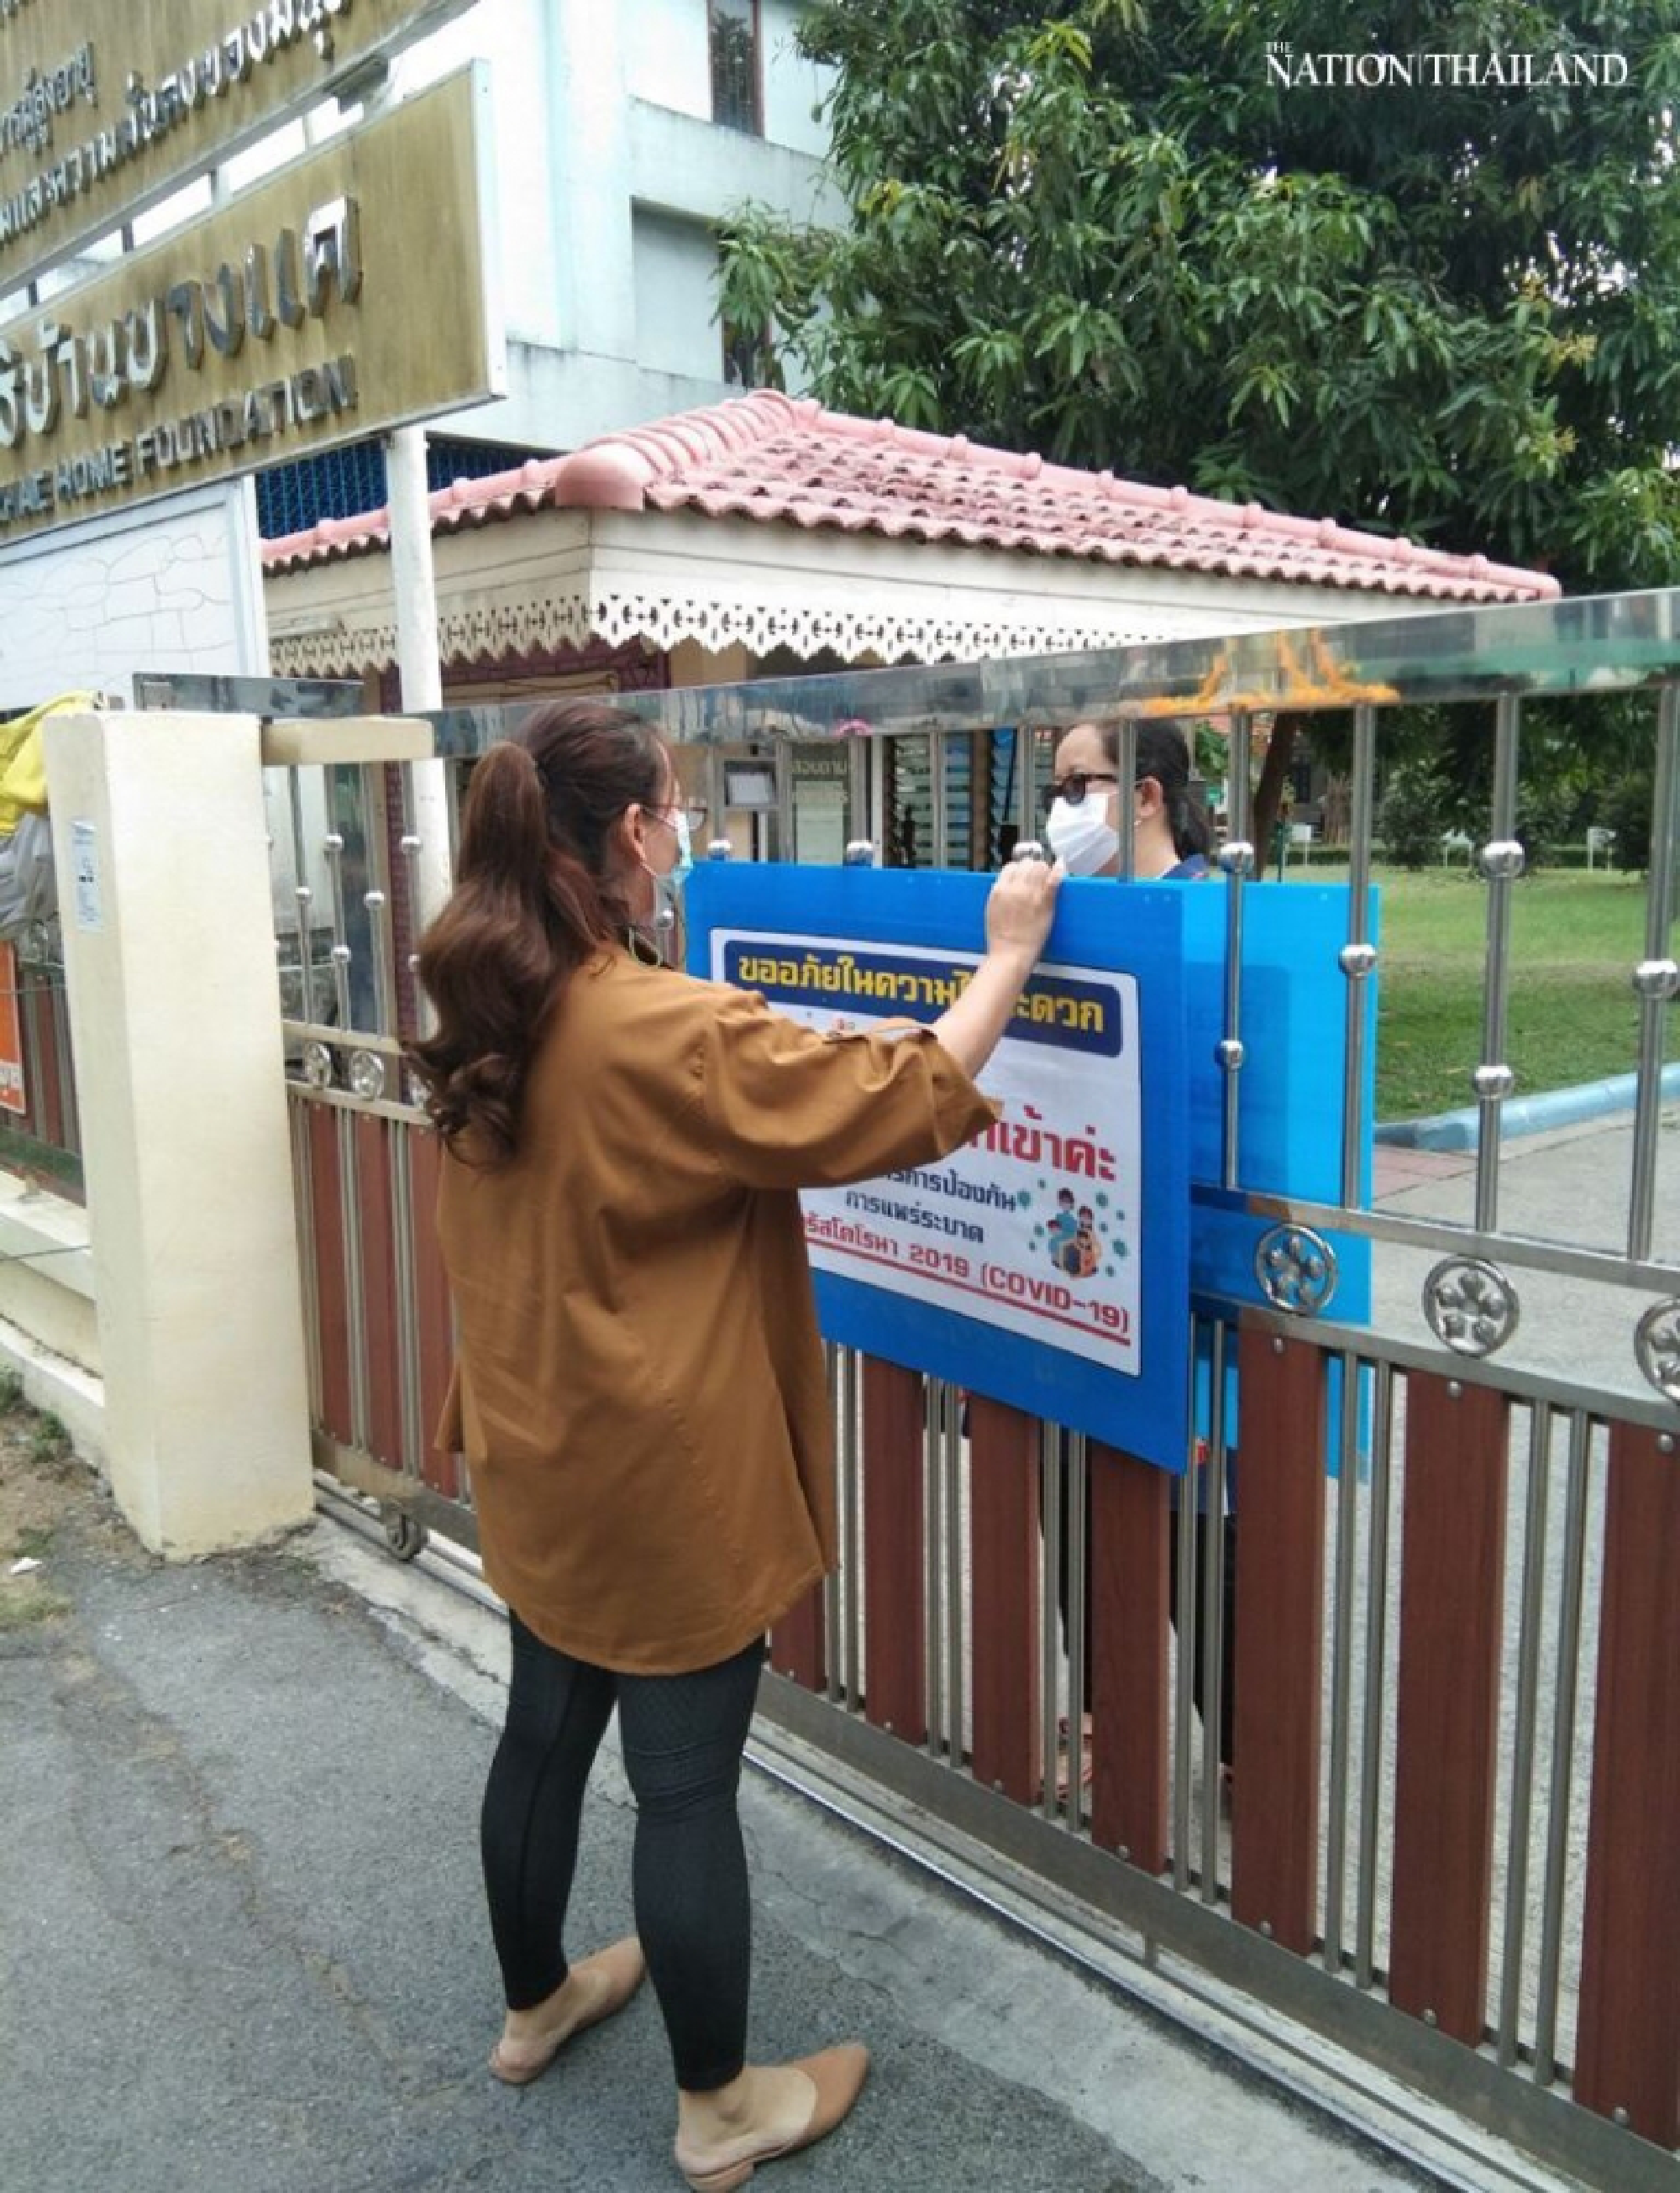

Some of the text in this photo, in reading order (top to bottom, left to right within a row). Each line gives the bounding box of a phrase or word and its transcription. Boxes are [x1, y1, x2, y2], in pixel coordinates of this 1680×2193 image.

[55, 441, 131, 502] HOME
[137, 356, 358, 475] FOUNDATION
[910, 1243, 970, 1278] 2019
[979, 1262, 1129, 1334] (COVID-19)
